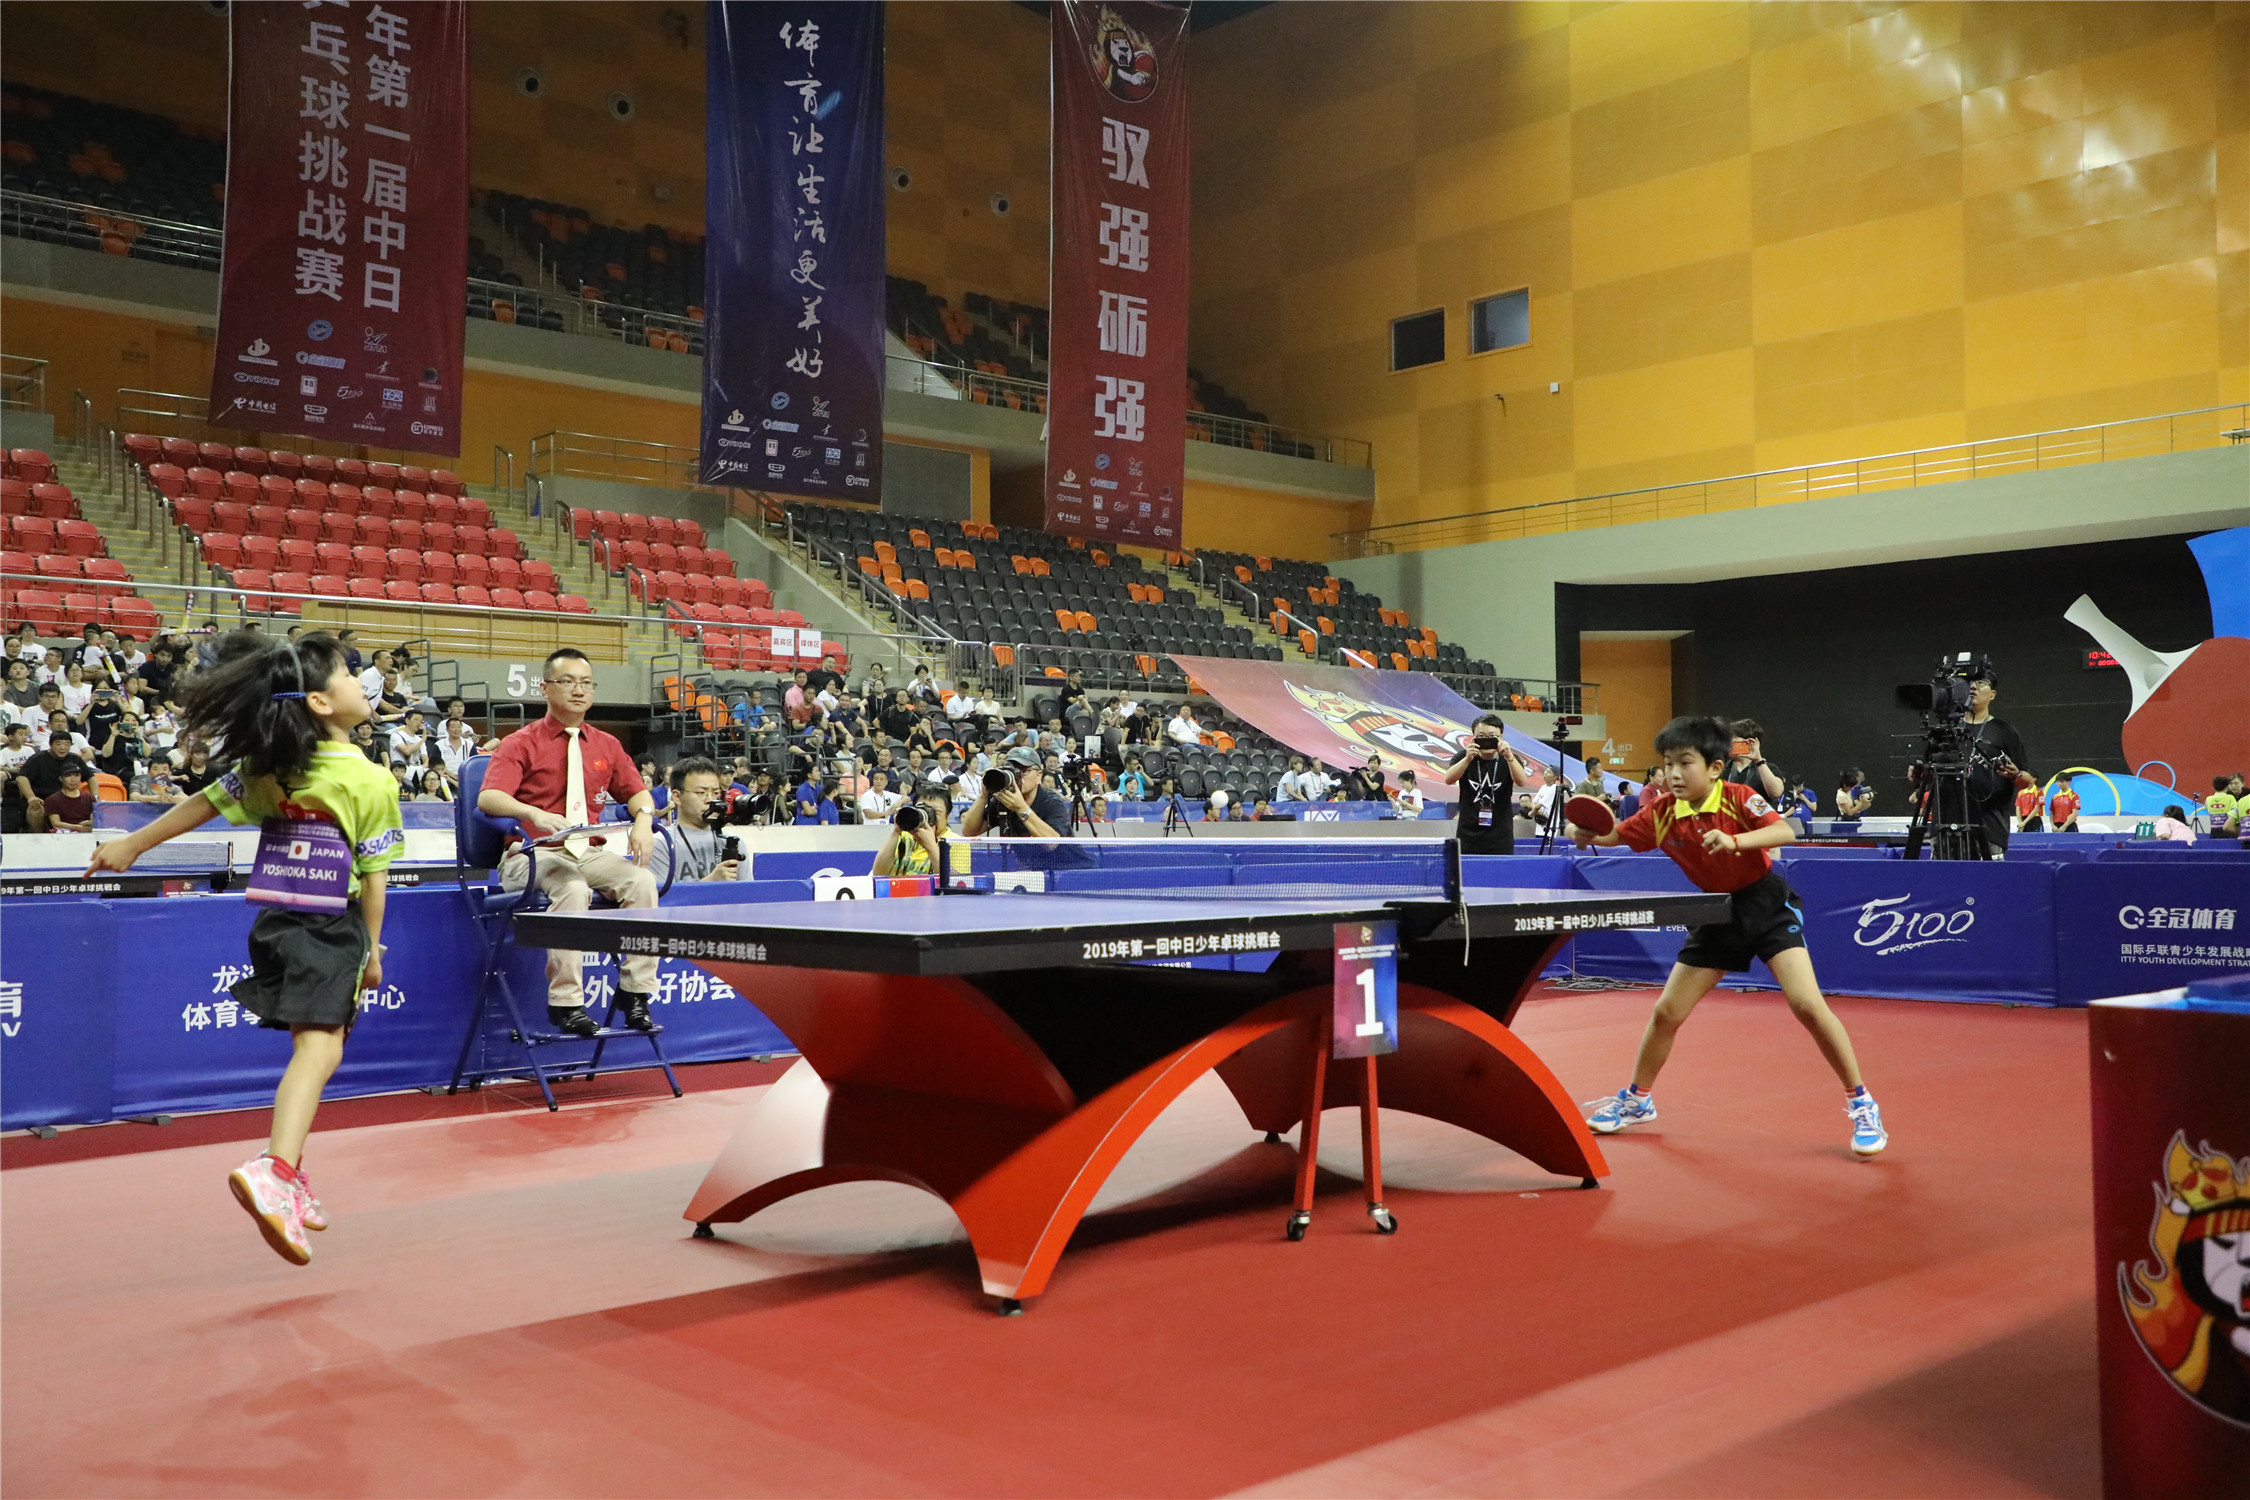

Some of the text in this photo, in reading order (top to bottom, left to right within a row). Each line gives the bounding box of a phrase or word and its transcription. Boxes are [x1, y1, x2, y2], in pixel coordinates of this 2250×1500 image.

[294, 0, 350, 302] 乓球挑战赛
[362, 4, 411, 313] 年第一届中日
[1094, 116, 1150, 443] 驭强砺强
[506, 664, 527, 697] 5
[1601, 738, 1616, 757] 4
[310, 848, 345, 859] JAPAN
[262, 863, 338, 882] YOSHIOKA SAKI
[1853, 893, 1975, 948] 5100
[2146, 907, 2237, 930] 全冠体育
[2166, 957, 2226, 966] DEVELOPMENT
[1355, 968, 1384, 1037] 1
